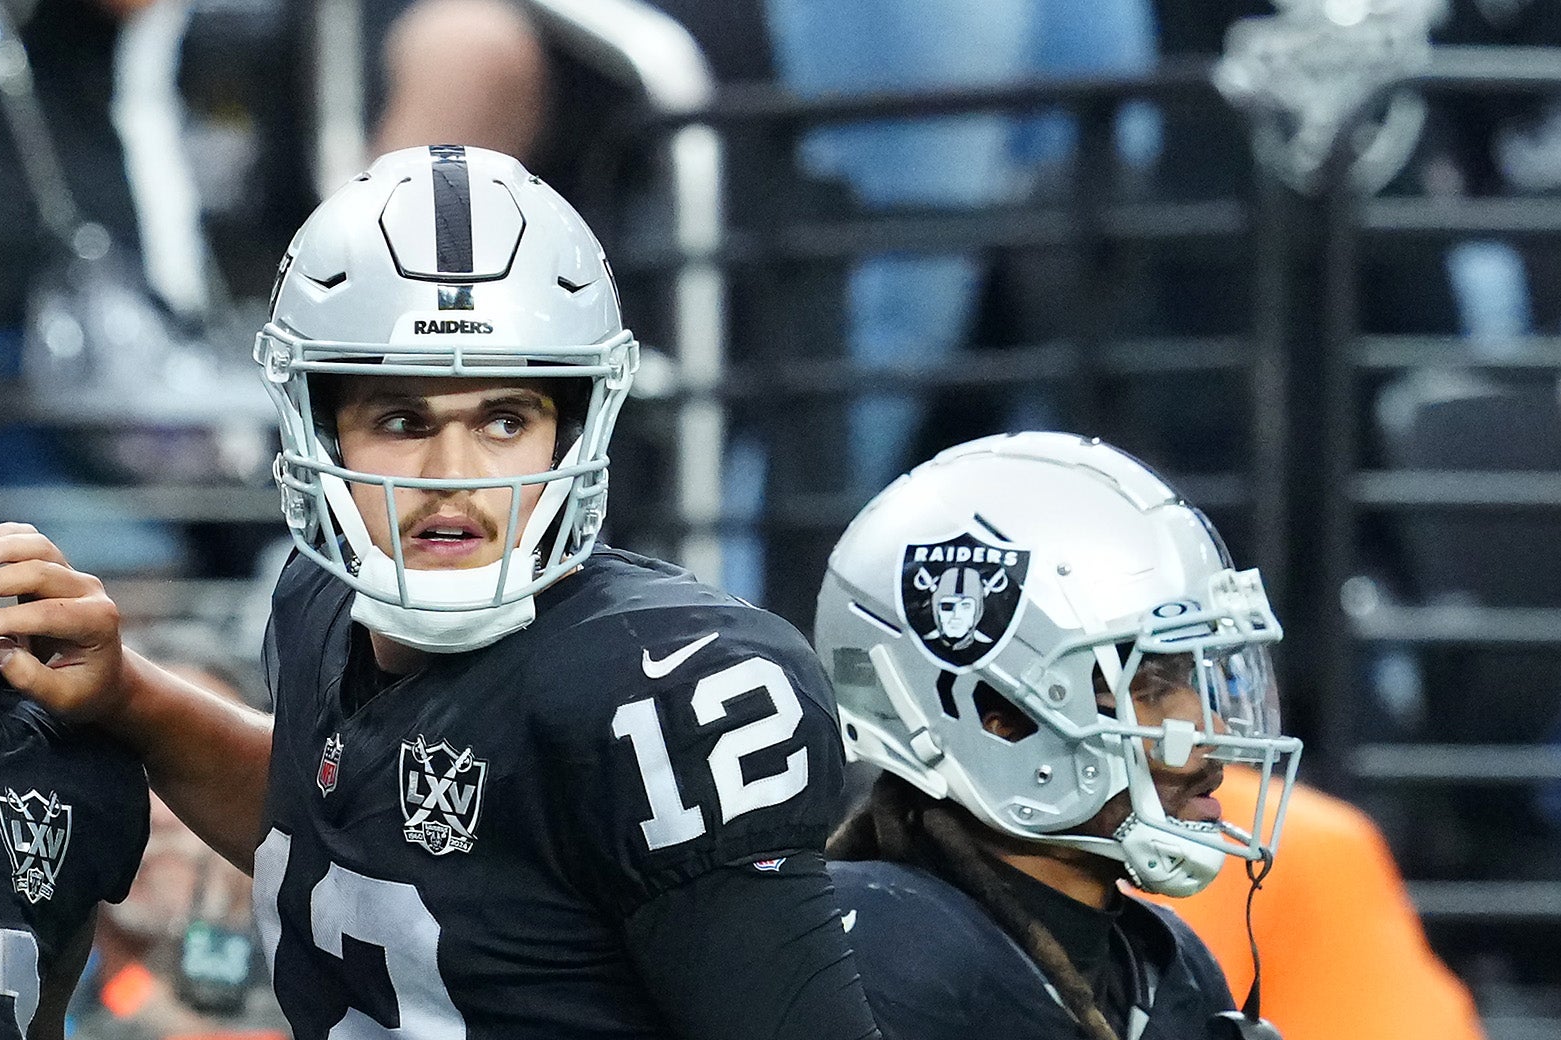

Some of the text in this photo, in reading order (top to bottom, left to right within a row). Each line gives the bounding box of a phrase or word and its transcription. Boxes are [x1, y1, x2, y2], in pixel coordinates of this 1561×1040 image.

[413, 319, 494, 335] RAIDERS
[913, 546, 1018, 567] RAIDERS
[612, 656, 809, 851] 12
[406, 770, 477, 815] LXV
[11, 820, 65, 860] LXV
